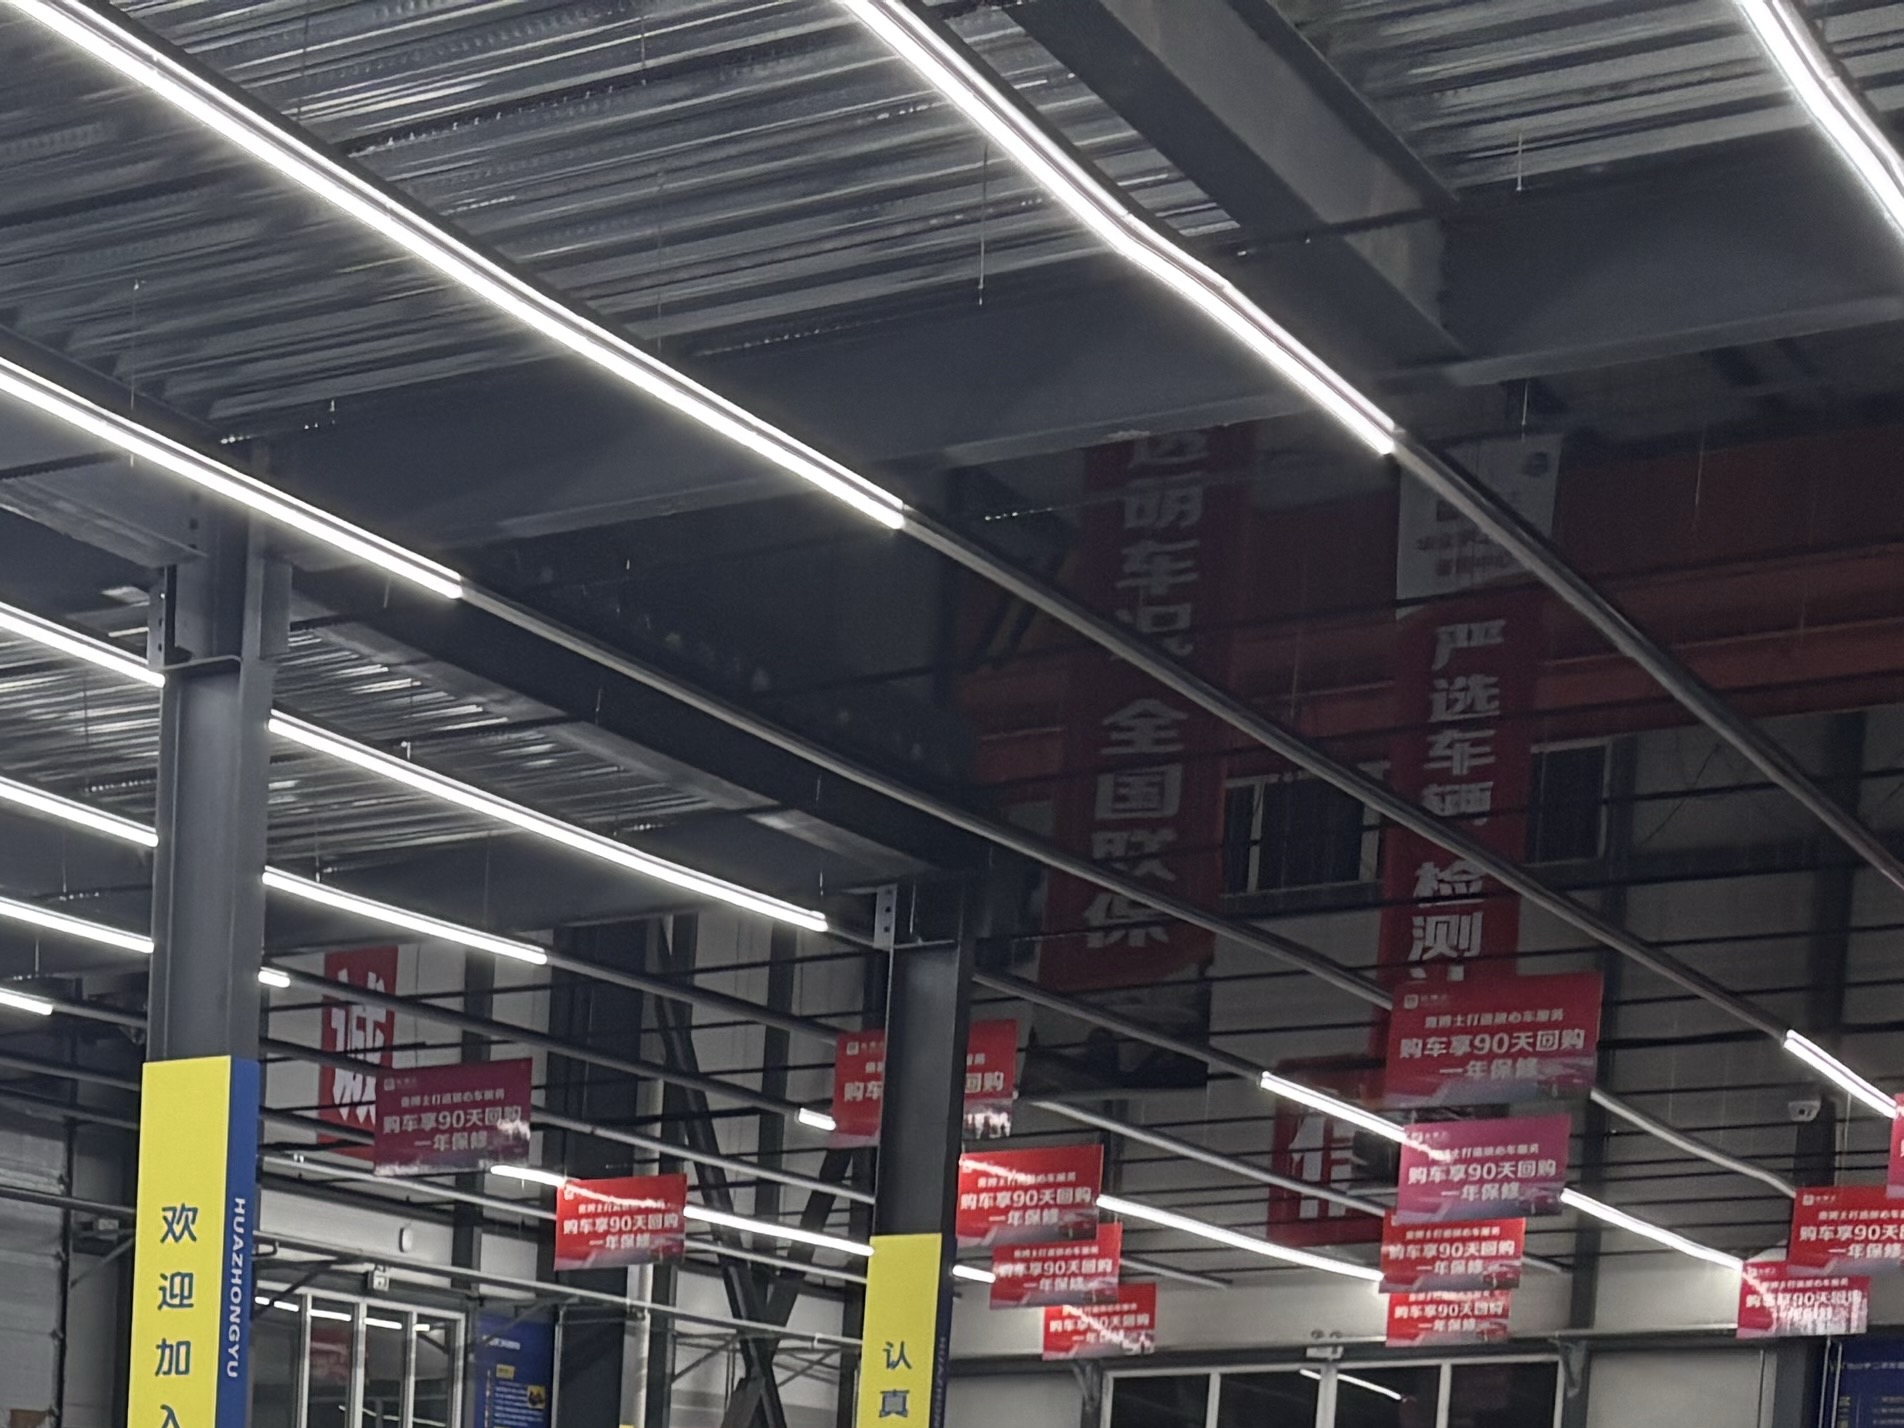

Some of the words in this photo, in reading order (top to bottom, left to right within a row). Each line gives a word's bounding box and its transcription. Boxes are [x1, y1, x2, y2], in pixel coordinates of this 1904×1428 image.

[1399, 1028, 1586, 1059] 购车享90天回购
[1439, 1057, 1539, 1079] 一年保修
[383, 1106, 522, 1134] 购车享90天回购
[414, 1131, 488, 1151] 一年保修
[1408, 1159, 1556, 1185] 购车享90天回购
[960, 1187, 1092, 1211] 购车享90天回购
[1441, 1182, 1520, 1201] 一年保修
[563, 1213, 679, 1235] 购车享90天回购
[988, 1208, 1060, 1226] 一年保修
[1389, 1240, 1515, 1260] 购车享90天回购
[1417, 1259, 1485, 1275] 一年保修
[227, 1198, 247, 1379] HUAZHONGYU
[1394, 1301, 1504, 1319] 购车享90天回购
